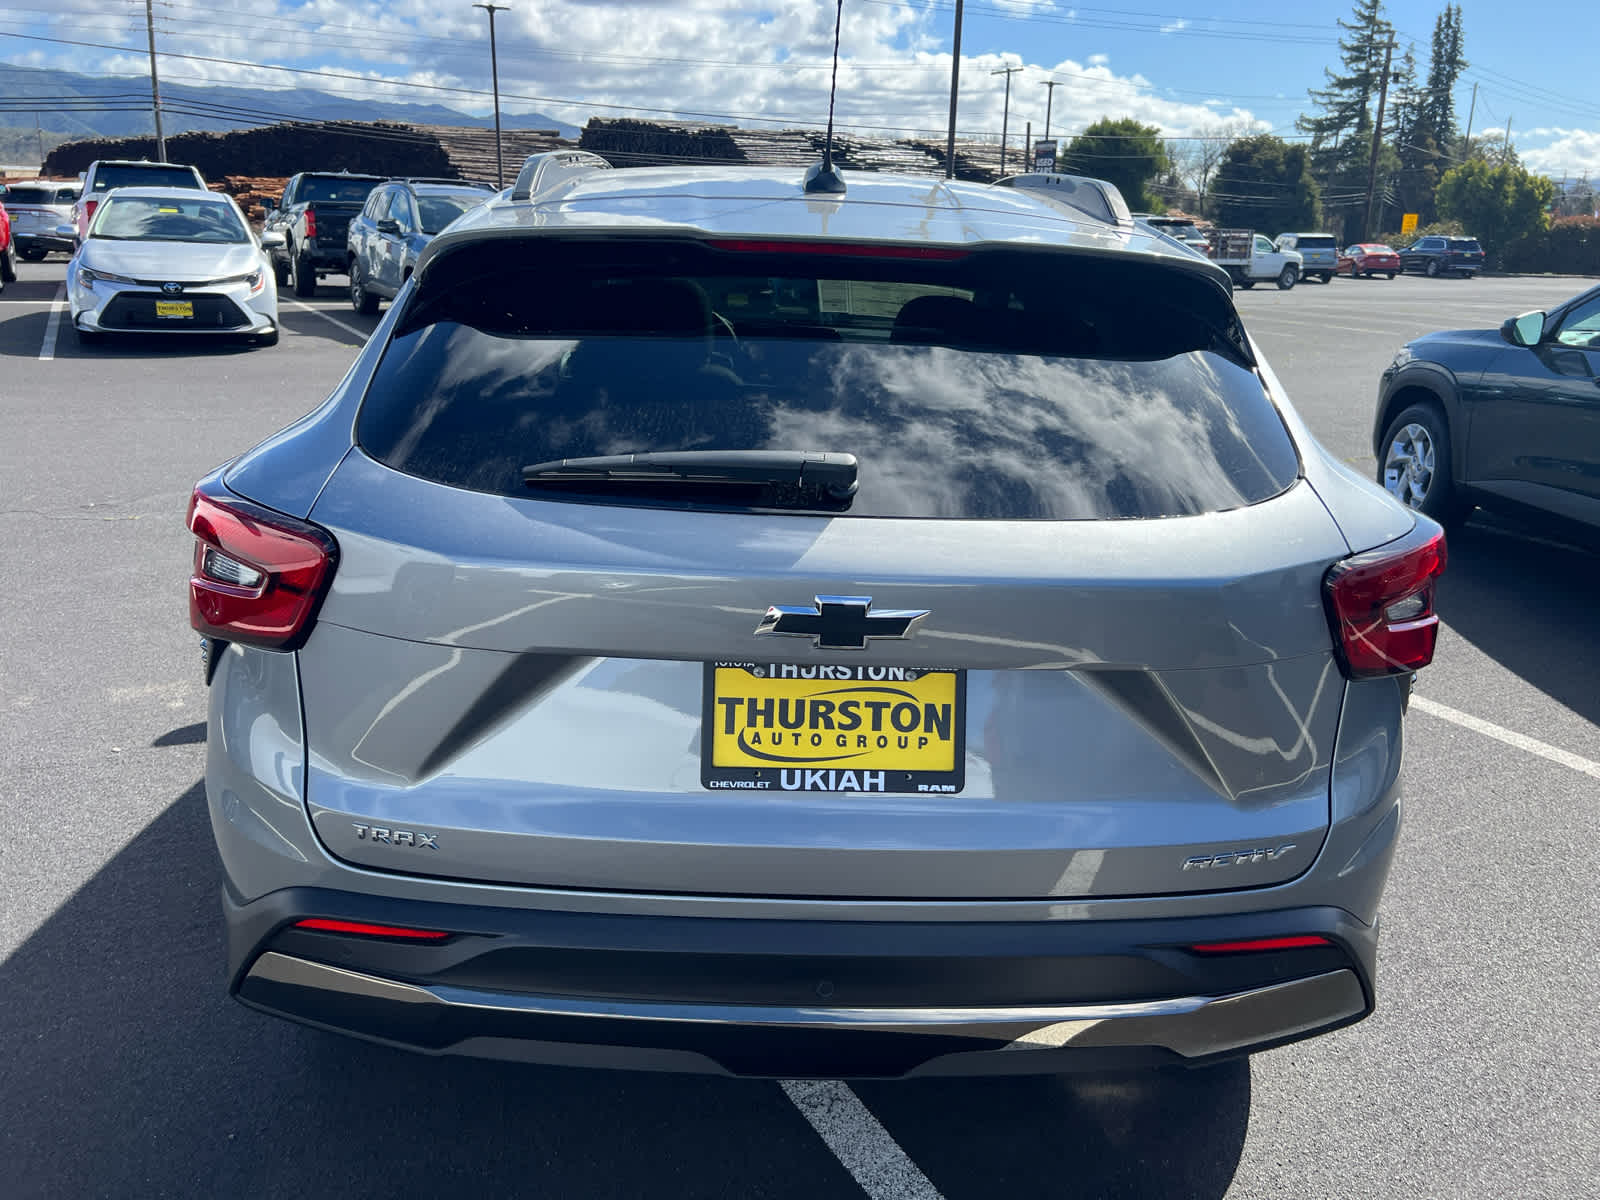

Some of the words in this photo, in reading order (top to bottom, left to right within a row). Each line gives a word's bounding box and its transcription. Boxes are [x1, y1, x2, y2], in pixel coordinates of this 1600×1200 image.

[717, 697, 952, 741] THURSTON
[751, 732, 822, 747] AUTO
[836, 733, 929, 750] GROUP
[710, 780, 771, 789] CHEVROLET
[780, 769, 886, 792] UKIAH
[918, 784, 956, 792] RAM
[351, 822, 440, 850] TRAX
[1181, 843, 1297, 871] ACTIV
